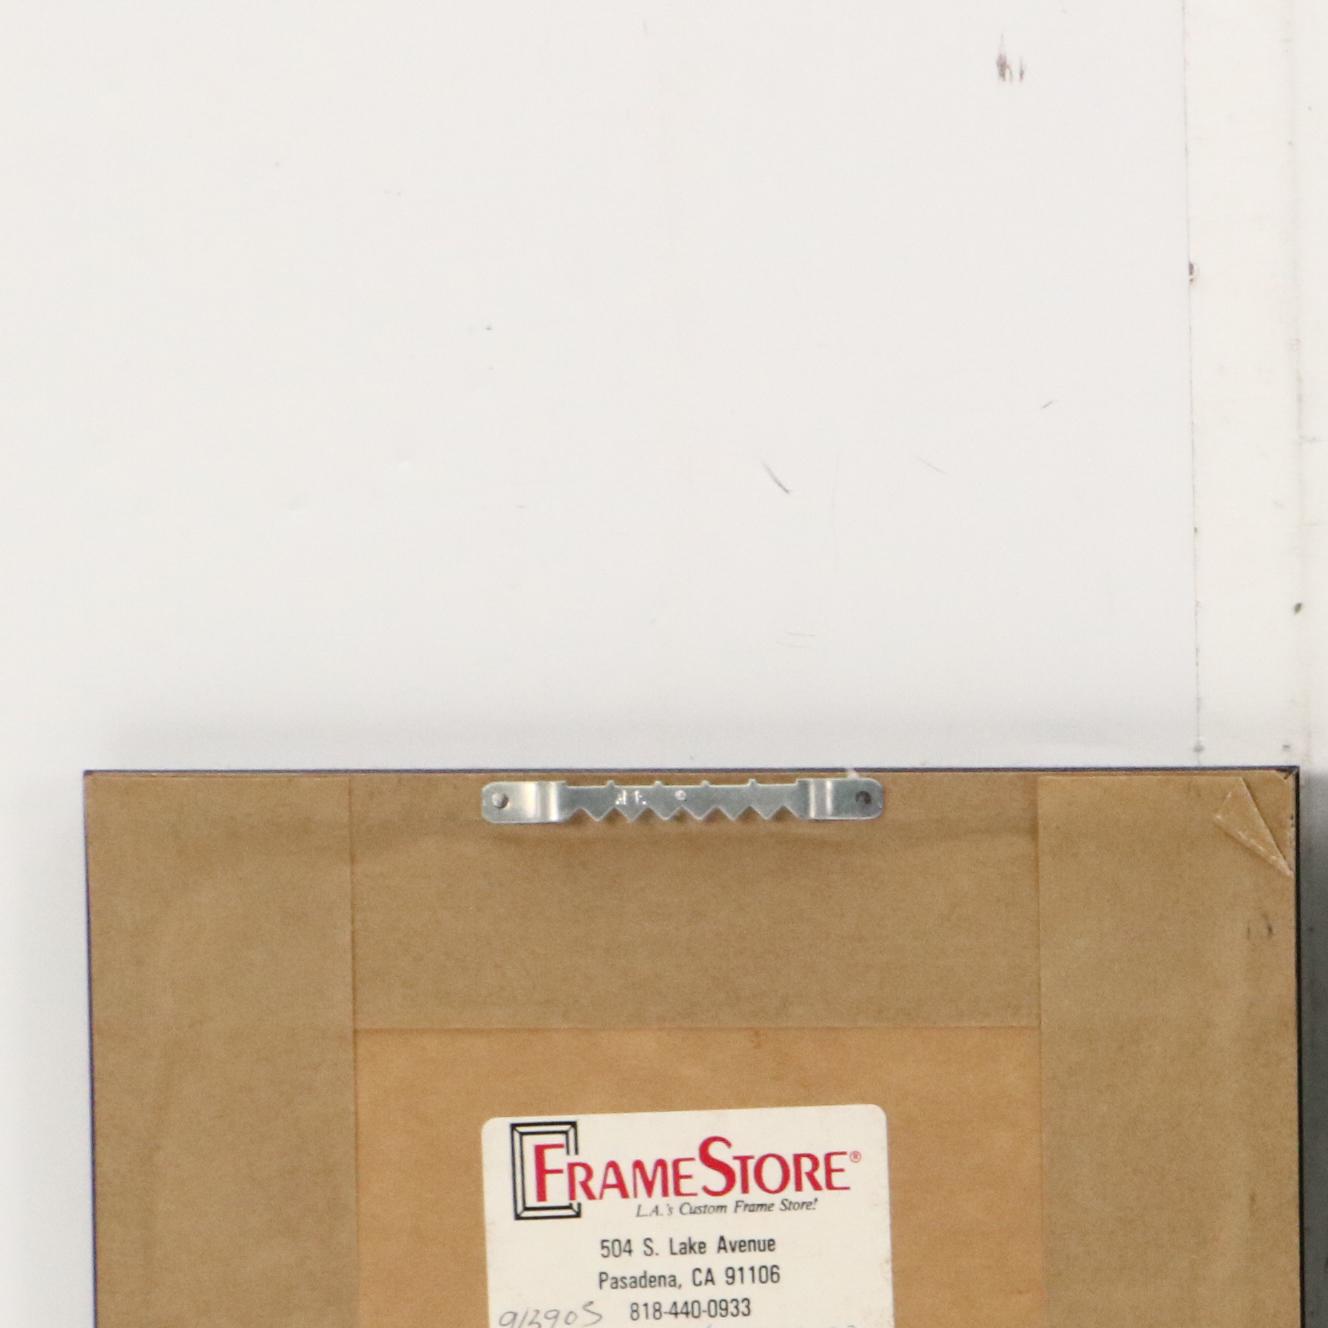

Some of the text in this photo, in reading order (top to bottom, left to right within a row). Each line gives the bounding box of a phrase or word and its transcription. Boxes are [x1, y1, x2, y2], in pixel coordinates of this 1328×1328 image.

[636, 1198, 818, 1218] L.A.'s Custom Frame Store!
[600, 1236, 776, 1257] 504 S. Lake Avenue
[599, 1266, 781, 1290] Pasadena, CA 91106
[630, 1298, 752, 1321] 818-440-0933
